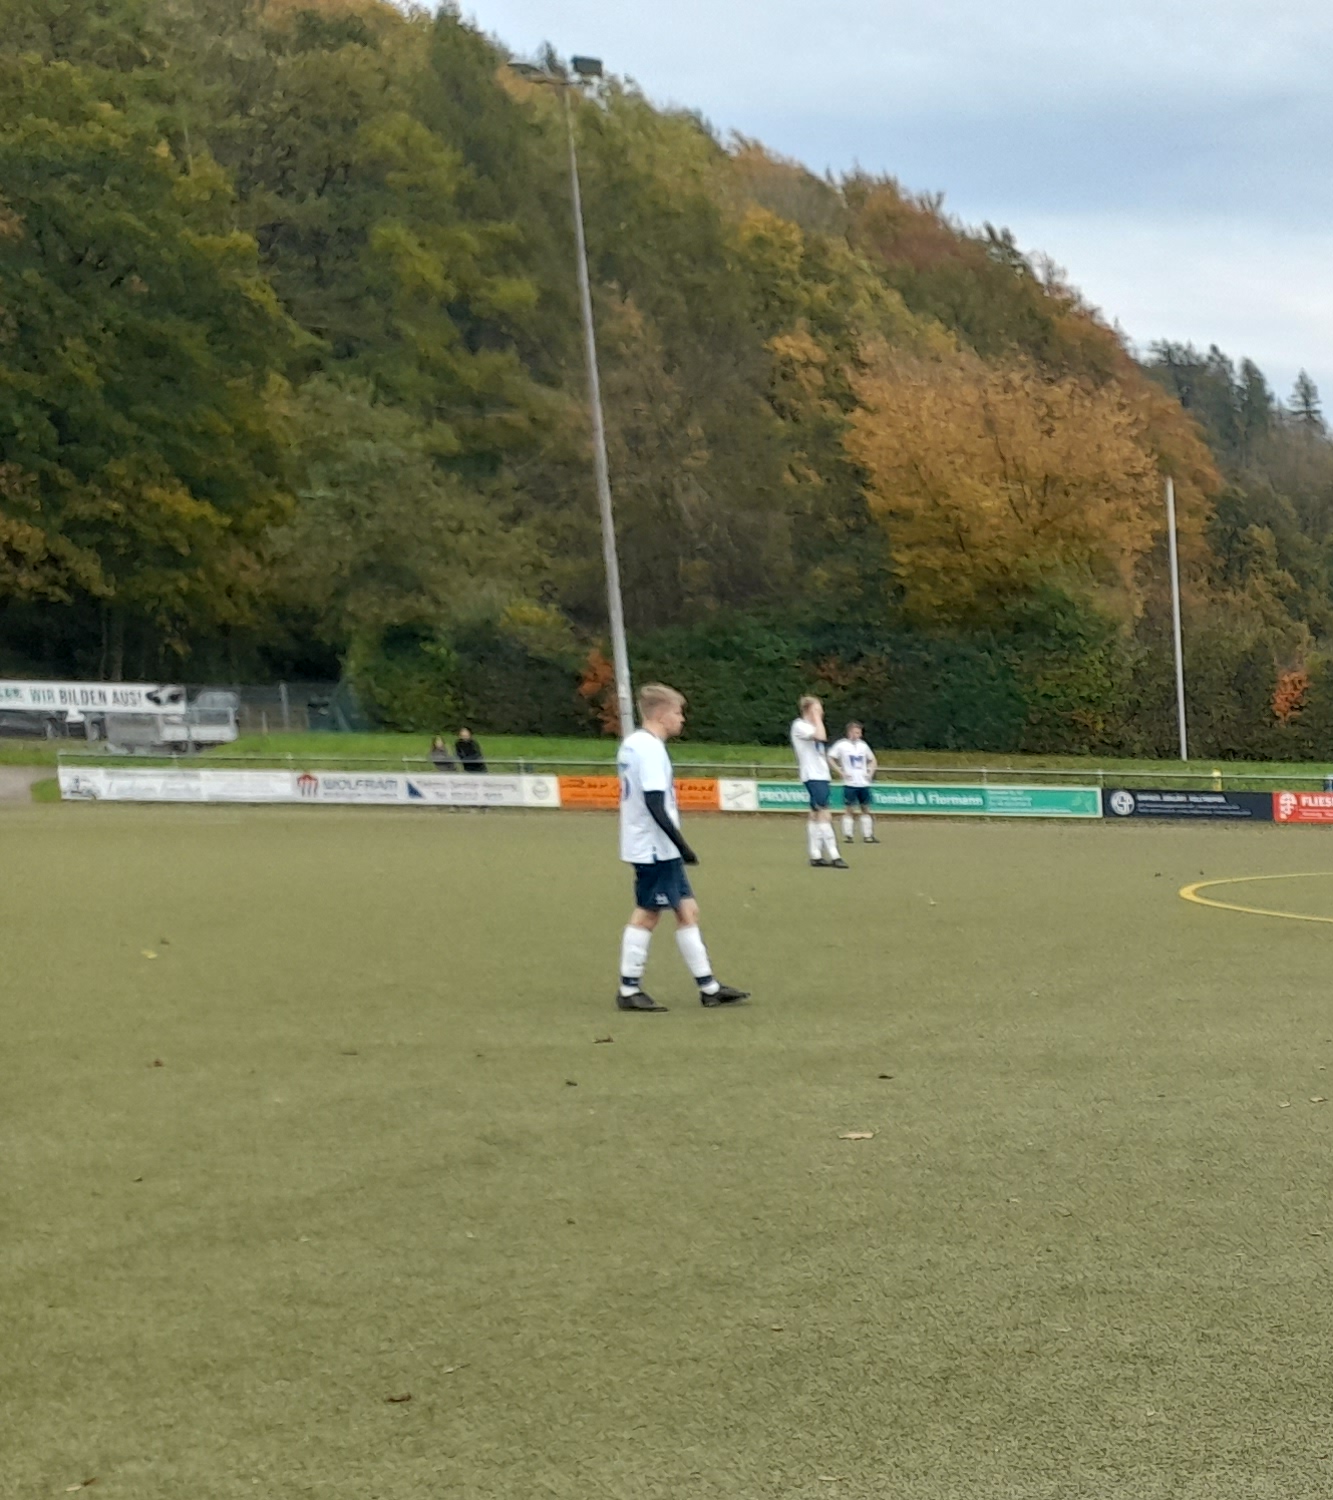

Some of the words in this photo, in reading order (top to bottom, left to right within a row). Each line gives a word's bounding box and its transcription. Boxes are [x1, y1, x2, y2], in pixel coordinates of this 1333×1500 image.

[30, 687, 55, 703] WIR
[59, 688, 107, 705] BILDEN
[112, 690, 142, 706] AUS!
